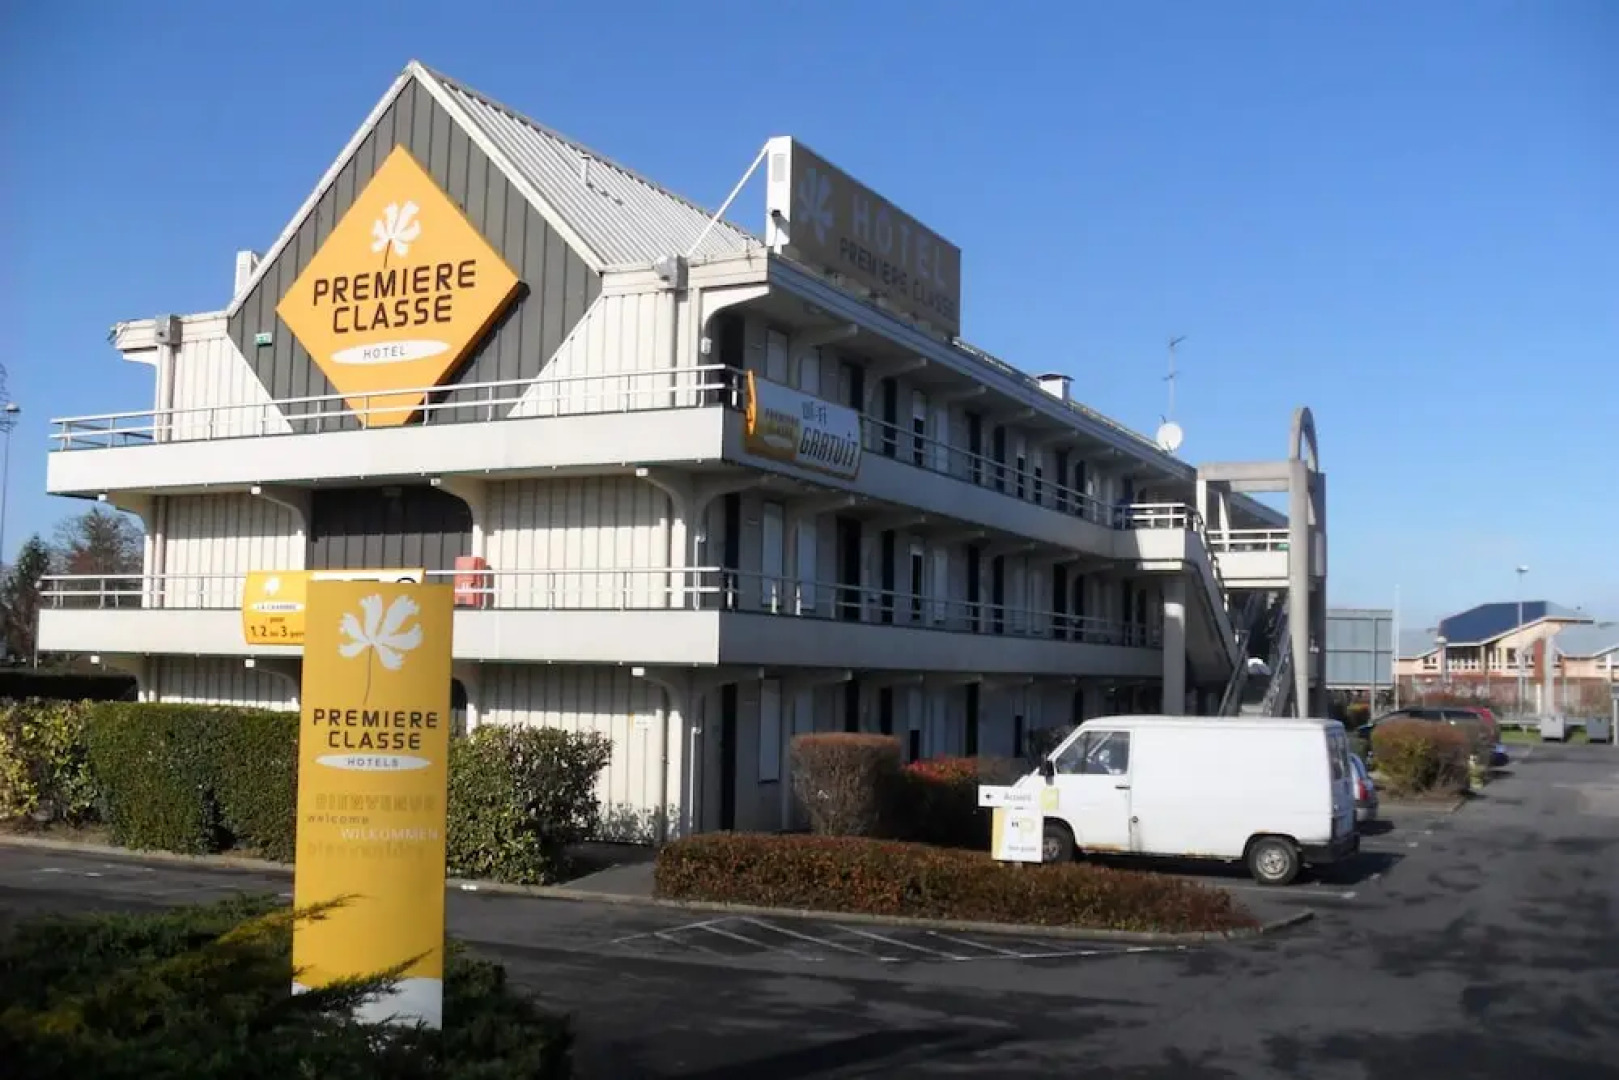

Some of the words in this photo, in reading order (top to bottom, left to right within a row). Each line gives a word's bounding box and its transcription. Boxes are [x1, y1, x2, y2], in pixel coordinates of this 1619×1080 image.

[313, 259, 476, 306] PREMIERE
[333, 294, 453, 334] CLASSE
[363, 345, 406, 360] HOTEL
[260, 624, 268, 637] 2
[280, 624, 288, 638] 3
[313, 708, 438, 728] PREMIERE
[328, 731, 421, 749] CLASSE
[347, 757, 399, 767] HOTELS
